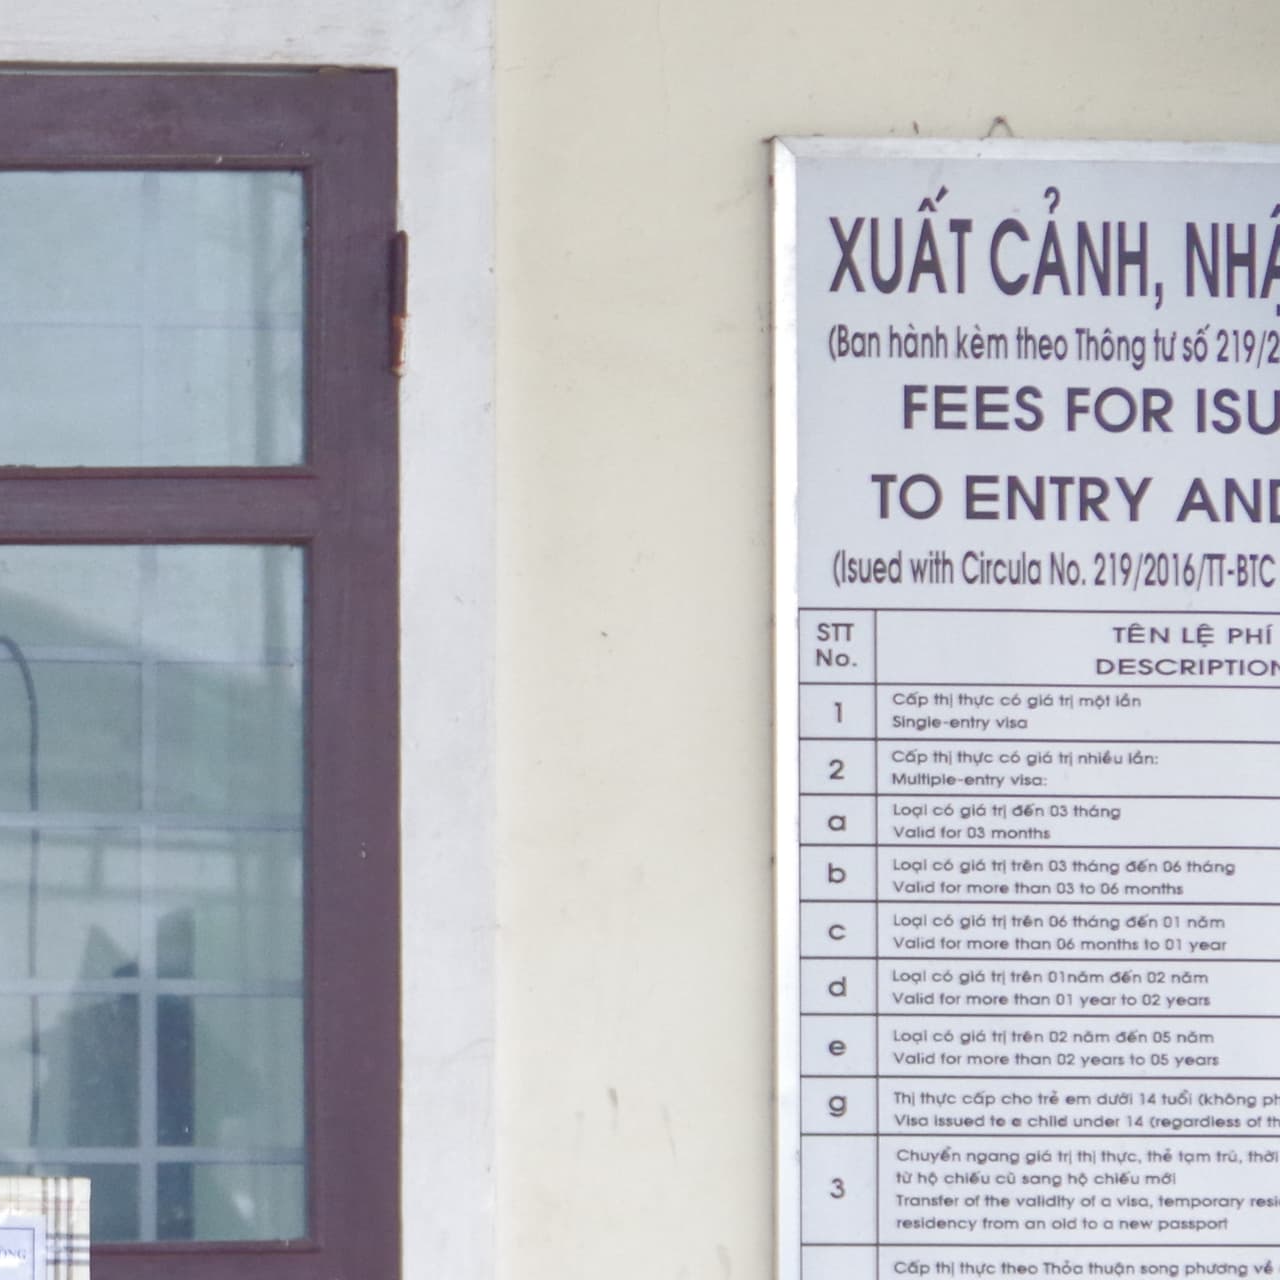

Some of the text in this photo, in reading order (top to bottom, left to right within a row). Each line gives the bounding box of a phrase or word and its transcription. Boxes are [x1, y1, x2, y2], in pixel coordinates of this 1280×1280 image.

[829, 185, 972, 295] XUẤT
[990, 186, 1163, 308] CẢNH,
[829, 324, 880, 361] (Ban
[889, 323, 948, 358] hành
[956, 324, 1008, 359] kèm
[1016, 327, 1068, 360] theo
[1075, 328, 1146, 370] Thông
[1153, 328, 1176, 362] tư
[1182, 325, 1210, 362] số
[904, 384, 1044, 431] FEES
[1067, 387, 1173, 433] FOR
[871, 472, 1280, 524] TO ENTRY AN
[833, 549, 1275, 591] (Isued with Circula No. 219/2016/TT-BTC
[816, 622, 855, 642] STT
[1112, 622, 1273, 648] TÊN LỆ PHÍ
[815, 648, 857, 667] No.
[834, 702, 842, 723] 1
[892, 715, 1028, 732] Single-entry visa
[829, 759, 844, 780] 2
[892, 773, 1047, 788] Multiple-entry visa:
[828, 815, 846, 831] a
[893, 825, 1051, 839] Valid for 03 months
[828, 863, 846, 884] b
[892, 881, 1184, 895] Valid for more than 03 to 06 months
[828, 924, 845, 940] c
[828, 976, 846, 997] d
[828, 1040, 846, 1056] e
[828, 1096, 847, 1117] g
[830, 1178, 845, 1199] 3
[895, 1216, 1228, 1232] residency from an old to a new passport
